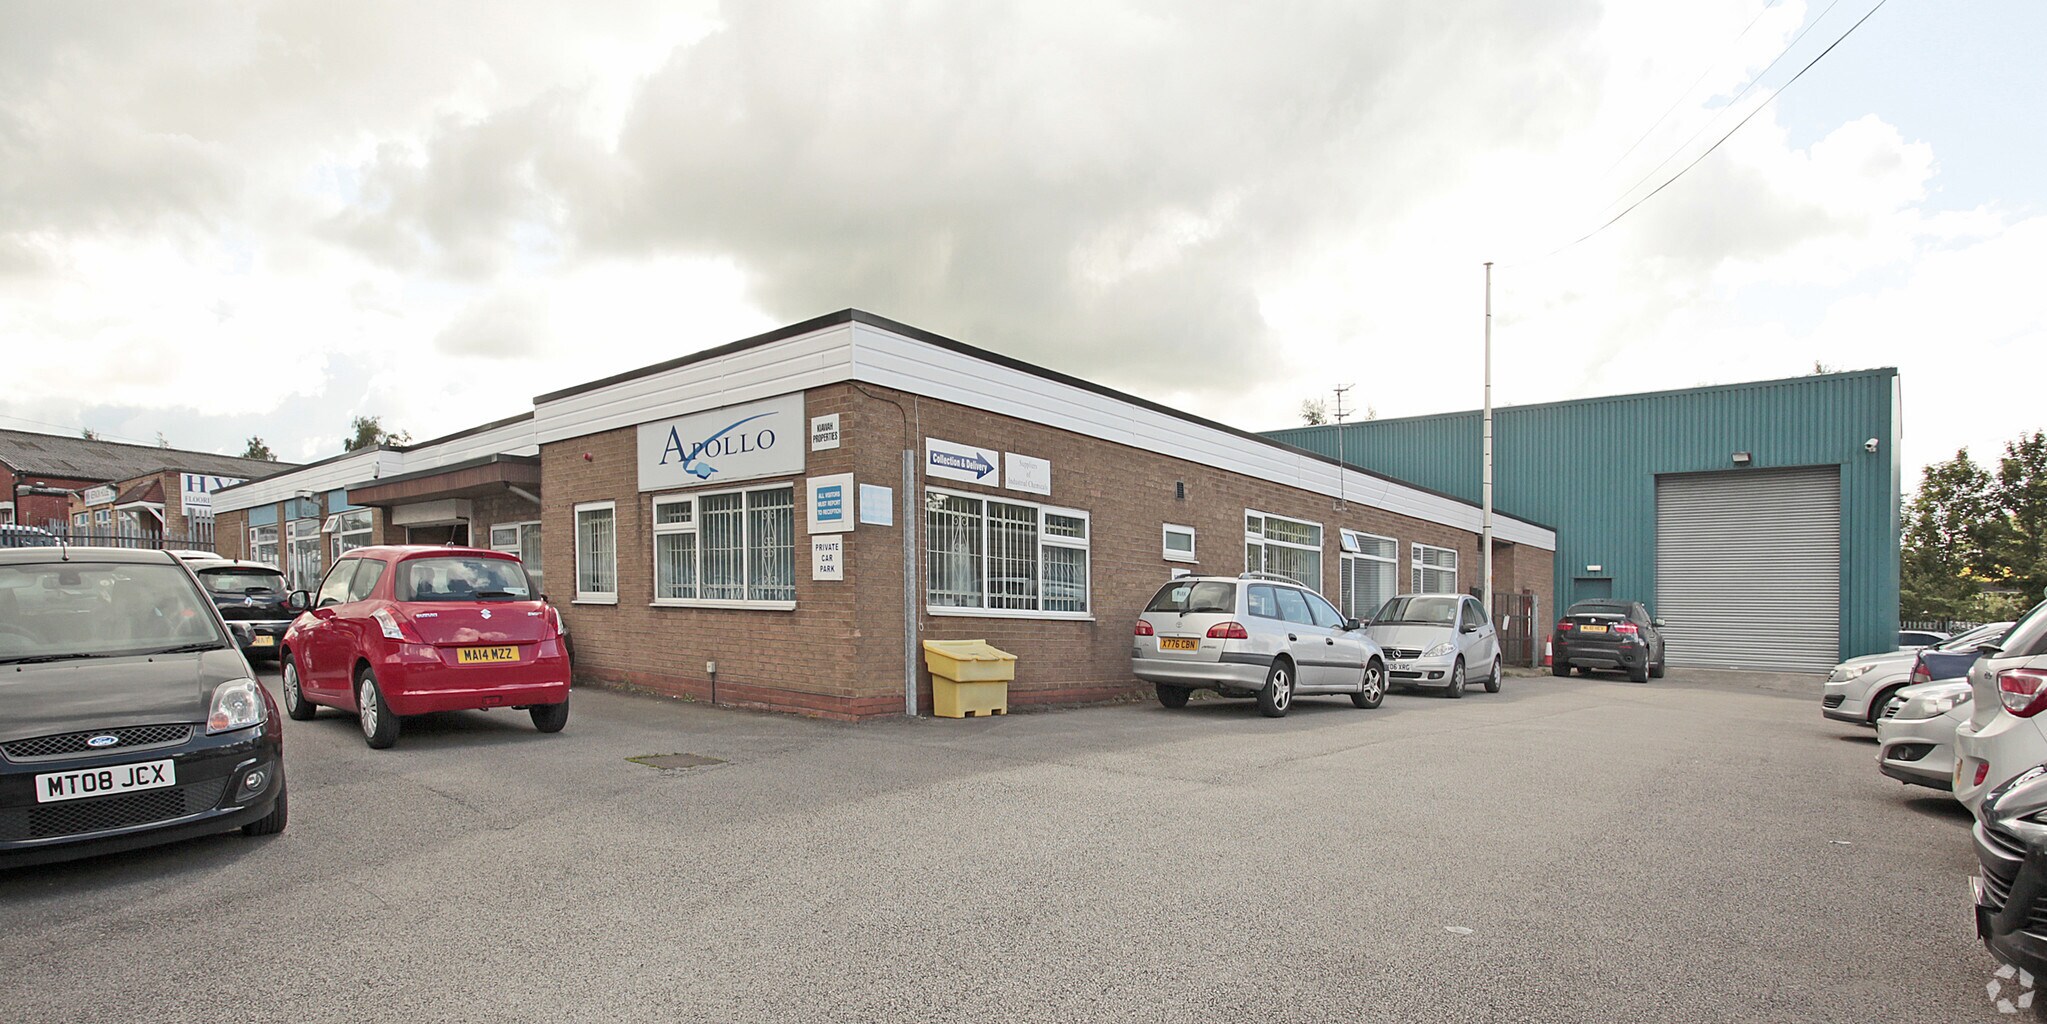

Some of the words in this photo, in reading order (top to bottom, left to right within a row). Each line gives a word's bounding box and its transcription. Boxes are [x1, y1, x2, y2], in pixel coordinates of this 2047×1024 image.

[813, 431, 838, 443] PROPERTIES
[658, 425, 776, 465] APOLLO
[932, 453, 960, 467] Collection
[961, 459, 966, 468] &
[966, 459, 988, 474] Delivery
[815, 543, 839, 551] PRIVATE
[821, 554, 833, 562] CAR
[1162, 640, 1180, 648] X776
[1181, 641, 1195, 649] CBN
[464, 649, 489, 661] MA14
[491, 648, 513, 660] MZZ
[47, 770, 113, 797] MT08
[121, 764, 166, 788] JCX
